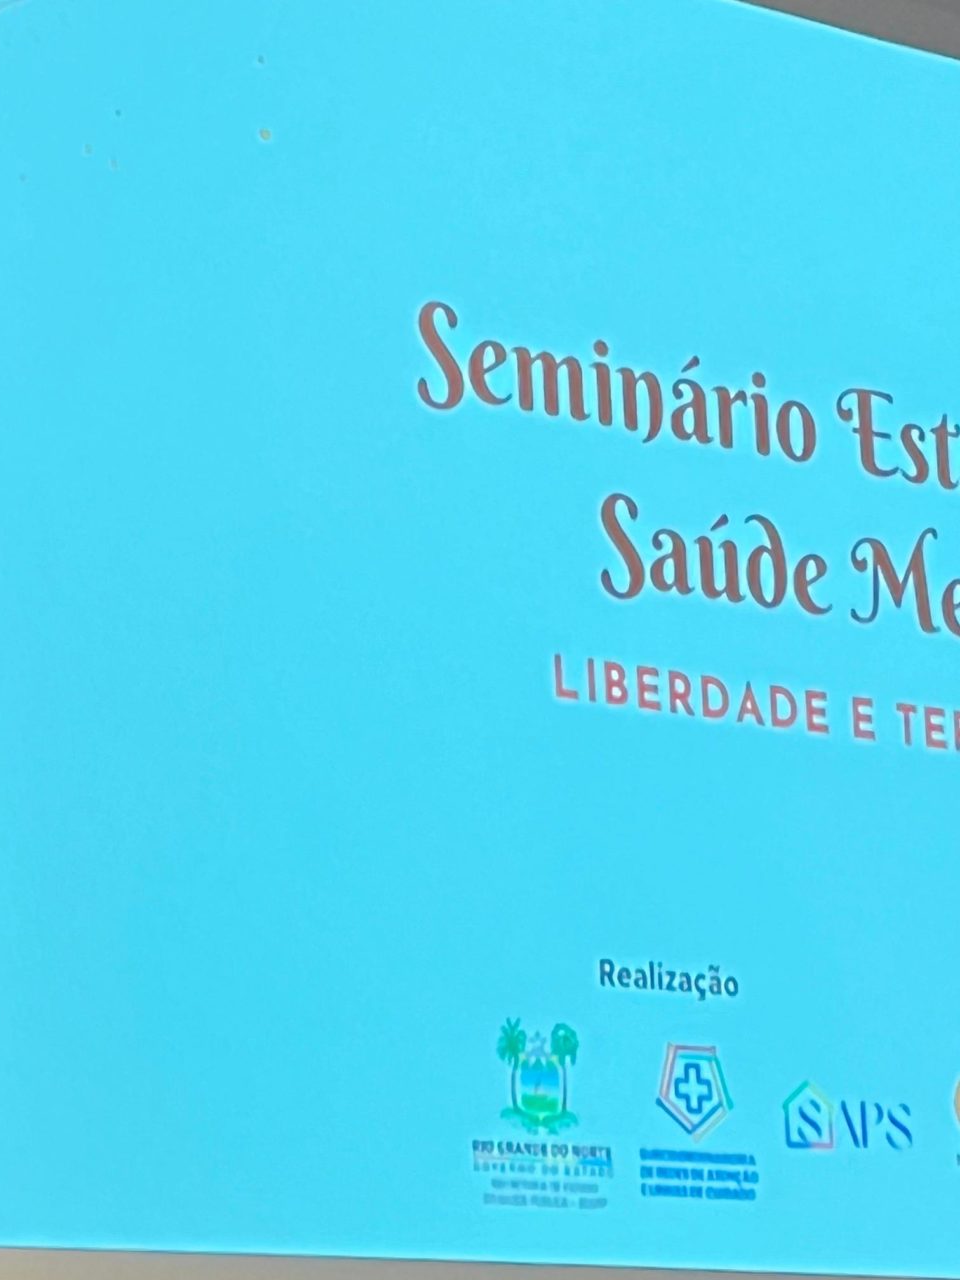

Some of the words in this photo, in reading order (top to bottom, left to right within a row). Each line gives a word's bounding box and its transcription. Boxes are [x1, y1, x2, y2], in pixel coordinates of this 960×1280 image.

[417, 300, 817, 463] Seminário
[836, 387, 960, 490] Est
[600, 492, 833, 615] Saúde
[554, 653, 830, 734] LIBERDADE
[851, 696, 876, 741] E
[599, 958, 739, 1001] Realização
